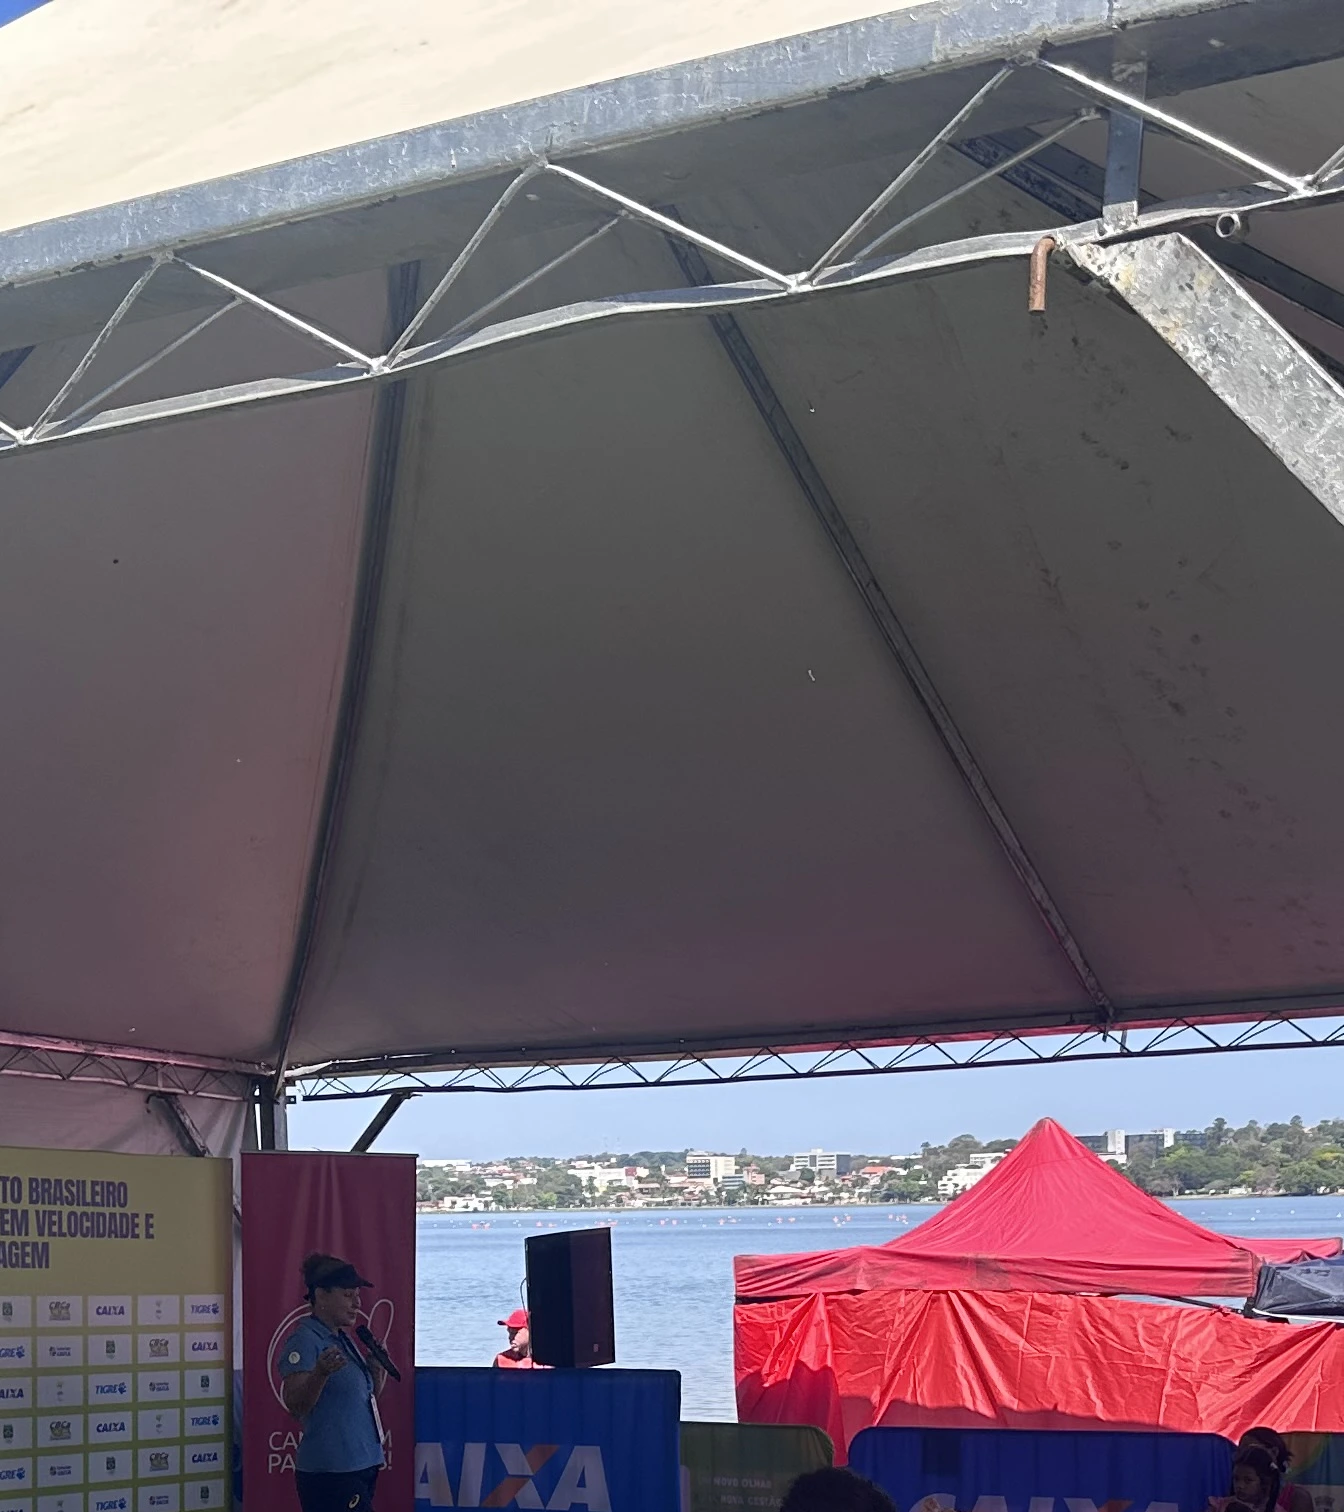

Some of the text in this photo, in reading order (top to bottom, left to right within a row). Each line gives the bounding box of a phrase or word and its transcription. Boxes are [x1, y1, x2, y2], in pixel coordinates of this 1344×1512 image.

[28, 1178, 128, 1208] BRASILEIRO
[34, 1209, 140, 1240] VELOCIDADE
[144, 1212, 155, 1240] E
[96, 1306, 125, 1316] CAIXA
[192, 1342, 218, 1352] CAIXA
[96, 1422, 126, 1433] CAIXA
[414, 1442, 613, 1512] AIXA
